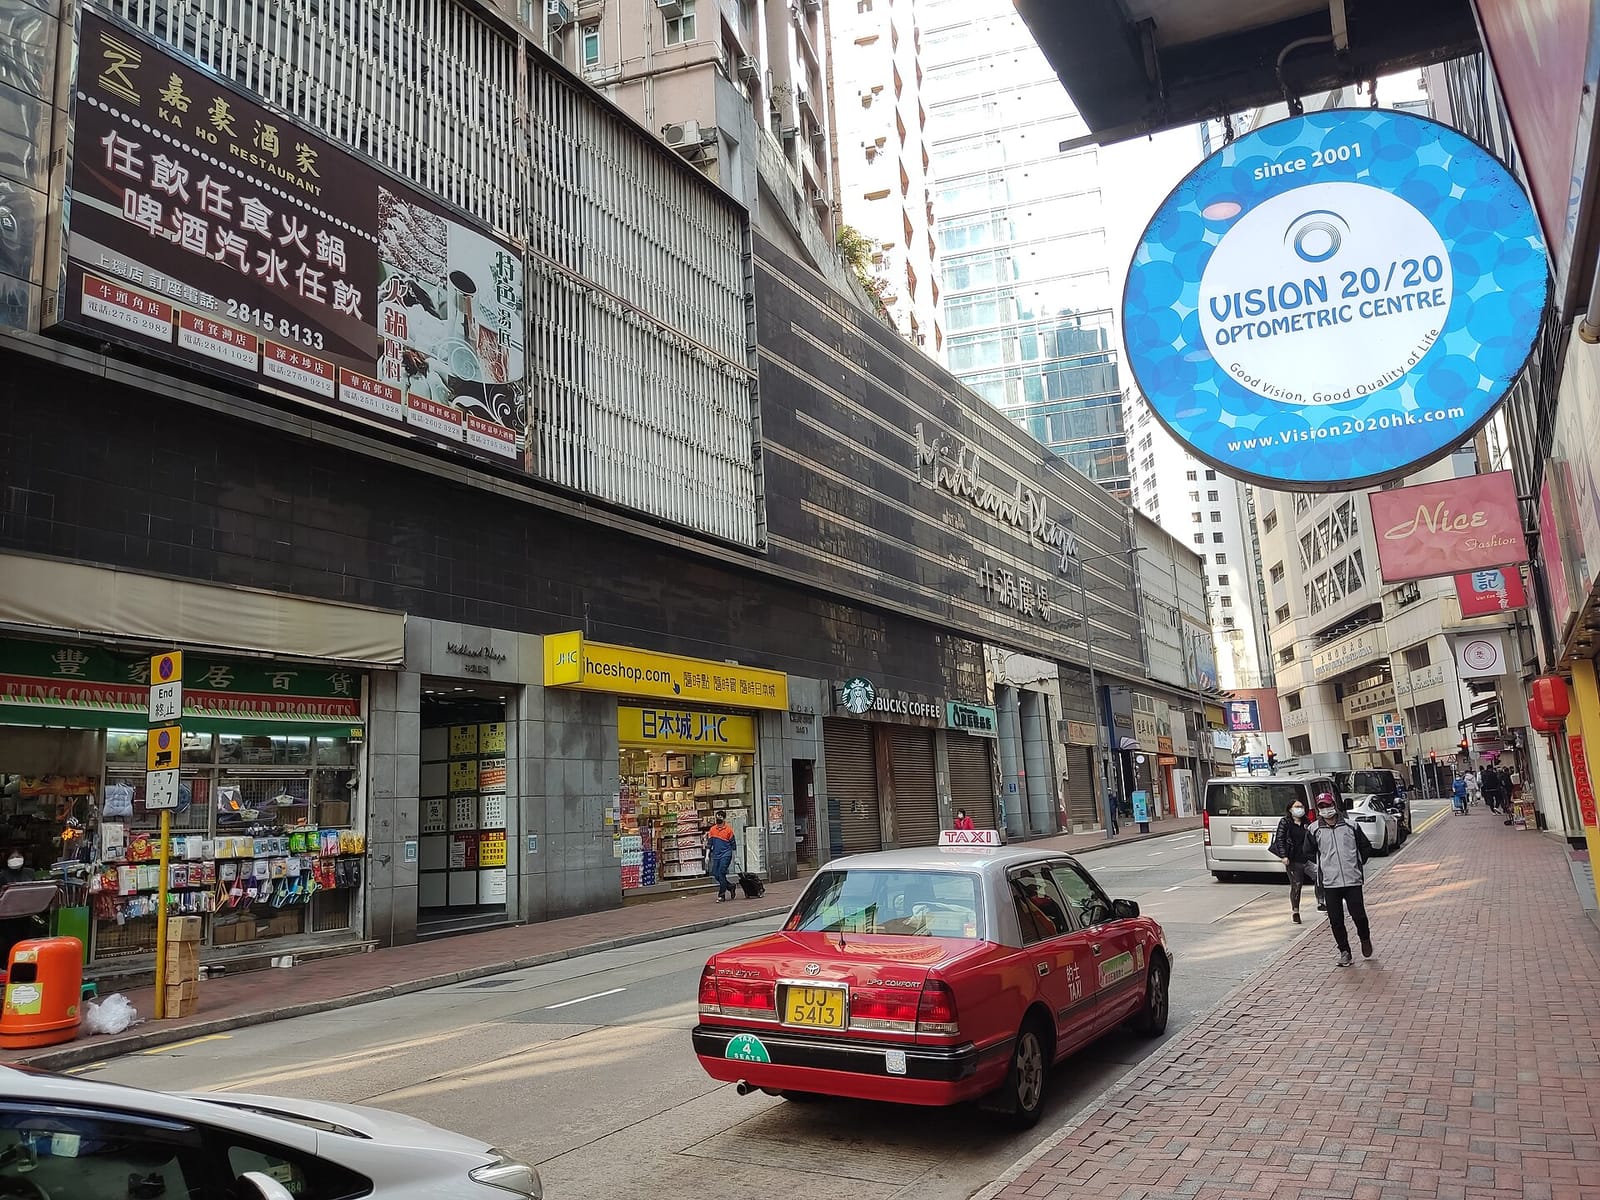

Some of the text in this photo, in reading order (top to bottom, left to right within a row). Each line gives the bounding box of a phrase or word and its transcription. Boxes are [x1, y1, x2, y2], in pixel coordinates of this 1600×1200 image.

[158, 72, 321, 178] 嘉豪酒家
[158, 107, 322, 197] KA HO RESTAURANT
[1253, 142, 1362, 181] since 2001
[101, 129, 346, 274] 任飲任食火鍋
[122, 188, 363, 321] 啤酒汽水任飲
[1210, 254, 1444, 322] VISION 20/20
[95, 253, 144, 283] 上環店
[226, 298, 274, 331] 2815
[280, 319, 324, 350] 8133
[99, 284, 160, 315] 牛頭角店
[141, 319, 168, 334] 2982
[1215, 287, 1446, 346] OPTOMETRIC CENTRE
[193, 317, 247, 347] 筲箕灣店
[383, 278, 409, 382] 火鍋配料
[1229, 326, 1440, 404] Good Vision, Good Quality of Life
[351, 375, 393, 399] 華富邨店
[1228, 405, 1465, 452] www.Vision2020hk.com
[1384, 501, 1488, 540] Nice
[1464, 534, 1517, 552] Fashion
[978, 561, 1051, 622] 中源廣場
[1476, 572, 1500, 589] 記
[556, 650, 577, 666] JHC
[67, 688, 150, 705] CONSUM
[158, 687, 173, 699] End
[155, 701, 175, 717] 終止
[908, 701, 941, 719] COFFEE
[641, 709, 728, 742] 日本城 JHC
[167, 772, 173, 784] 7
[166, 792, 172, 804] 7
[944, 831, 992, 844] TAXI
[1066, 962, 1080, 981] 的士
[866, 978, 921, 988] LPG COMFORT
[1068, 980, 1082, 1002] TAXI
[803, 988, 827, 1006] UJ
[794, 1005, 835, 1025] 5413
[738, 1035, 755, 1044] TAXI
[743, 1043, 751, 1055] 4
